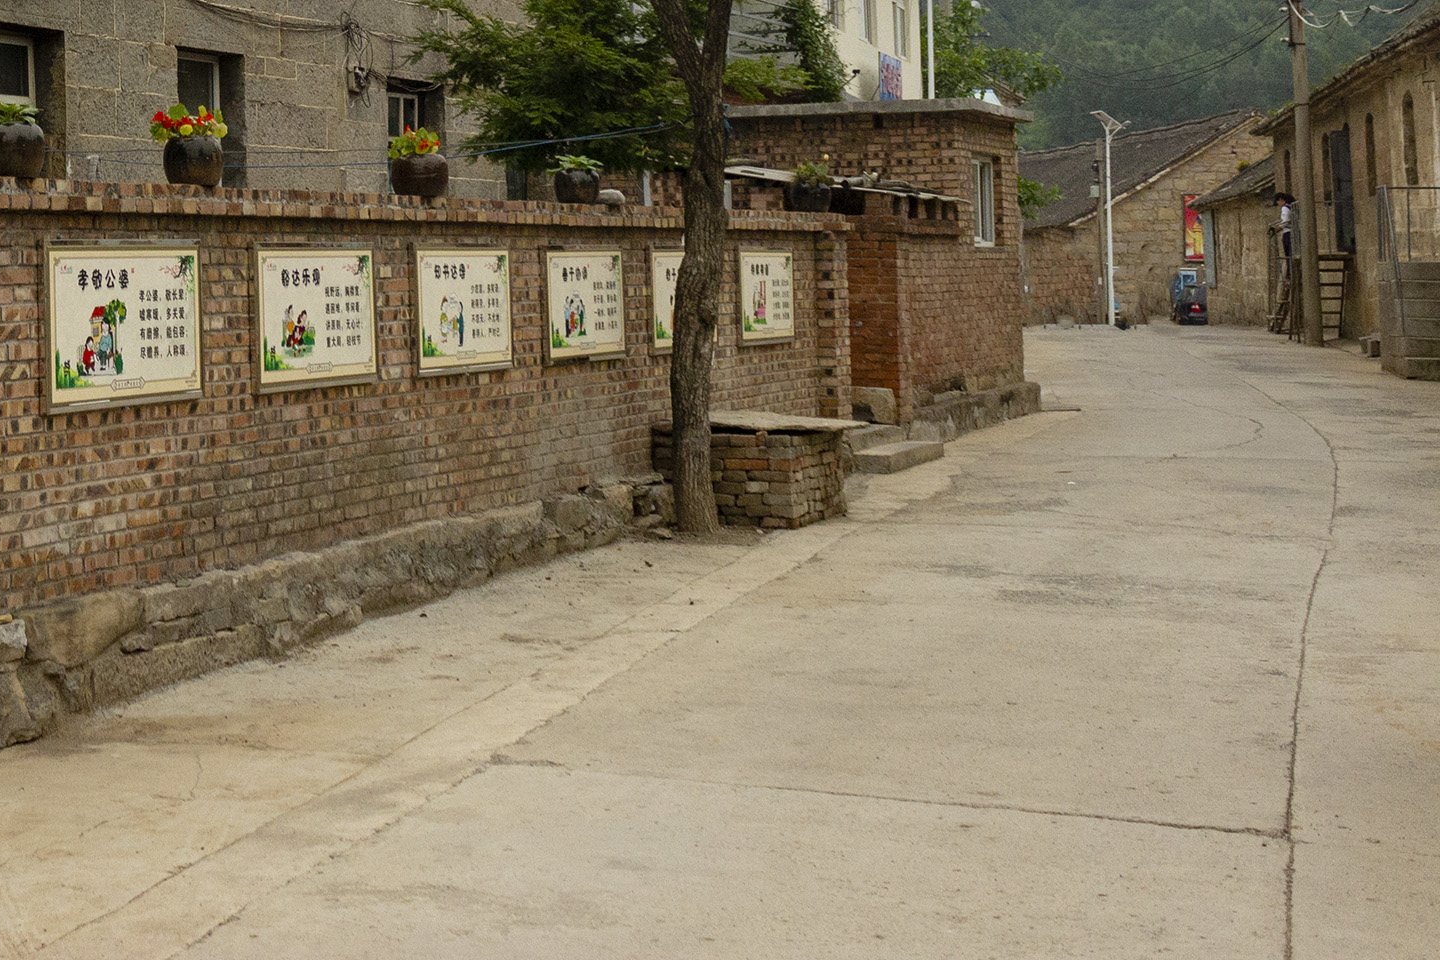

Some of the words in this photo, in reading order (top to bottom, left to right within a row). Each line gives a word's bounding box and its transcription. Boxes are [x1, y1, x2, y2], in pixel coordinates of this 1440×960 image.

[77, 269, 129, 291] 孝敬公婆
[281, 268, 321, 287] 豁达乐观
